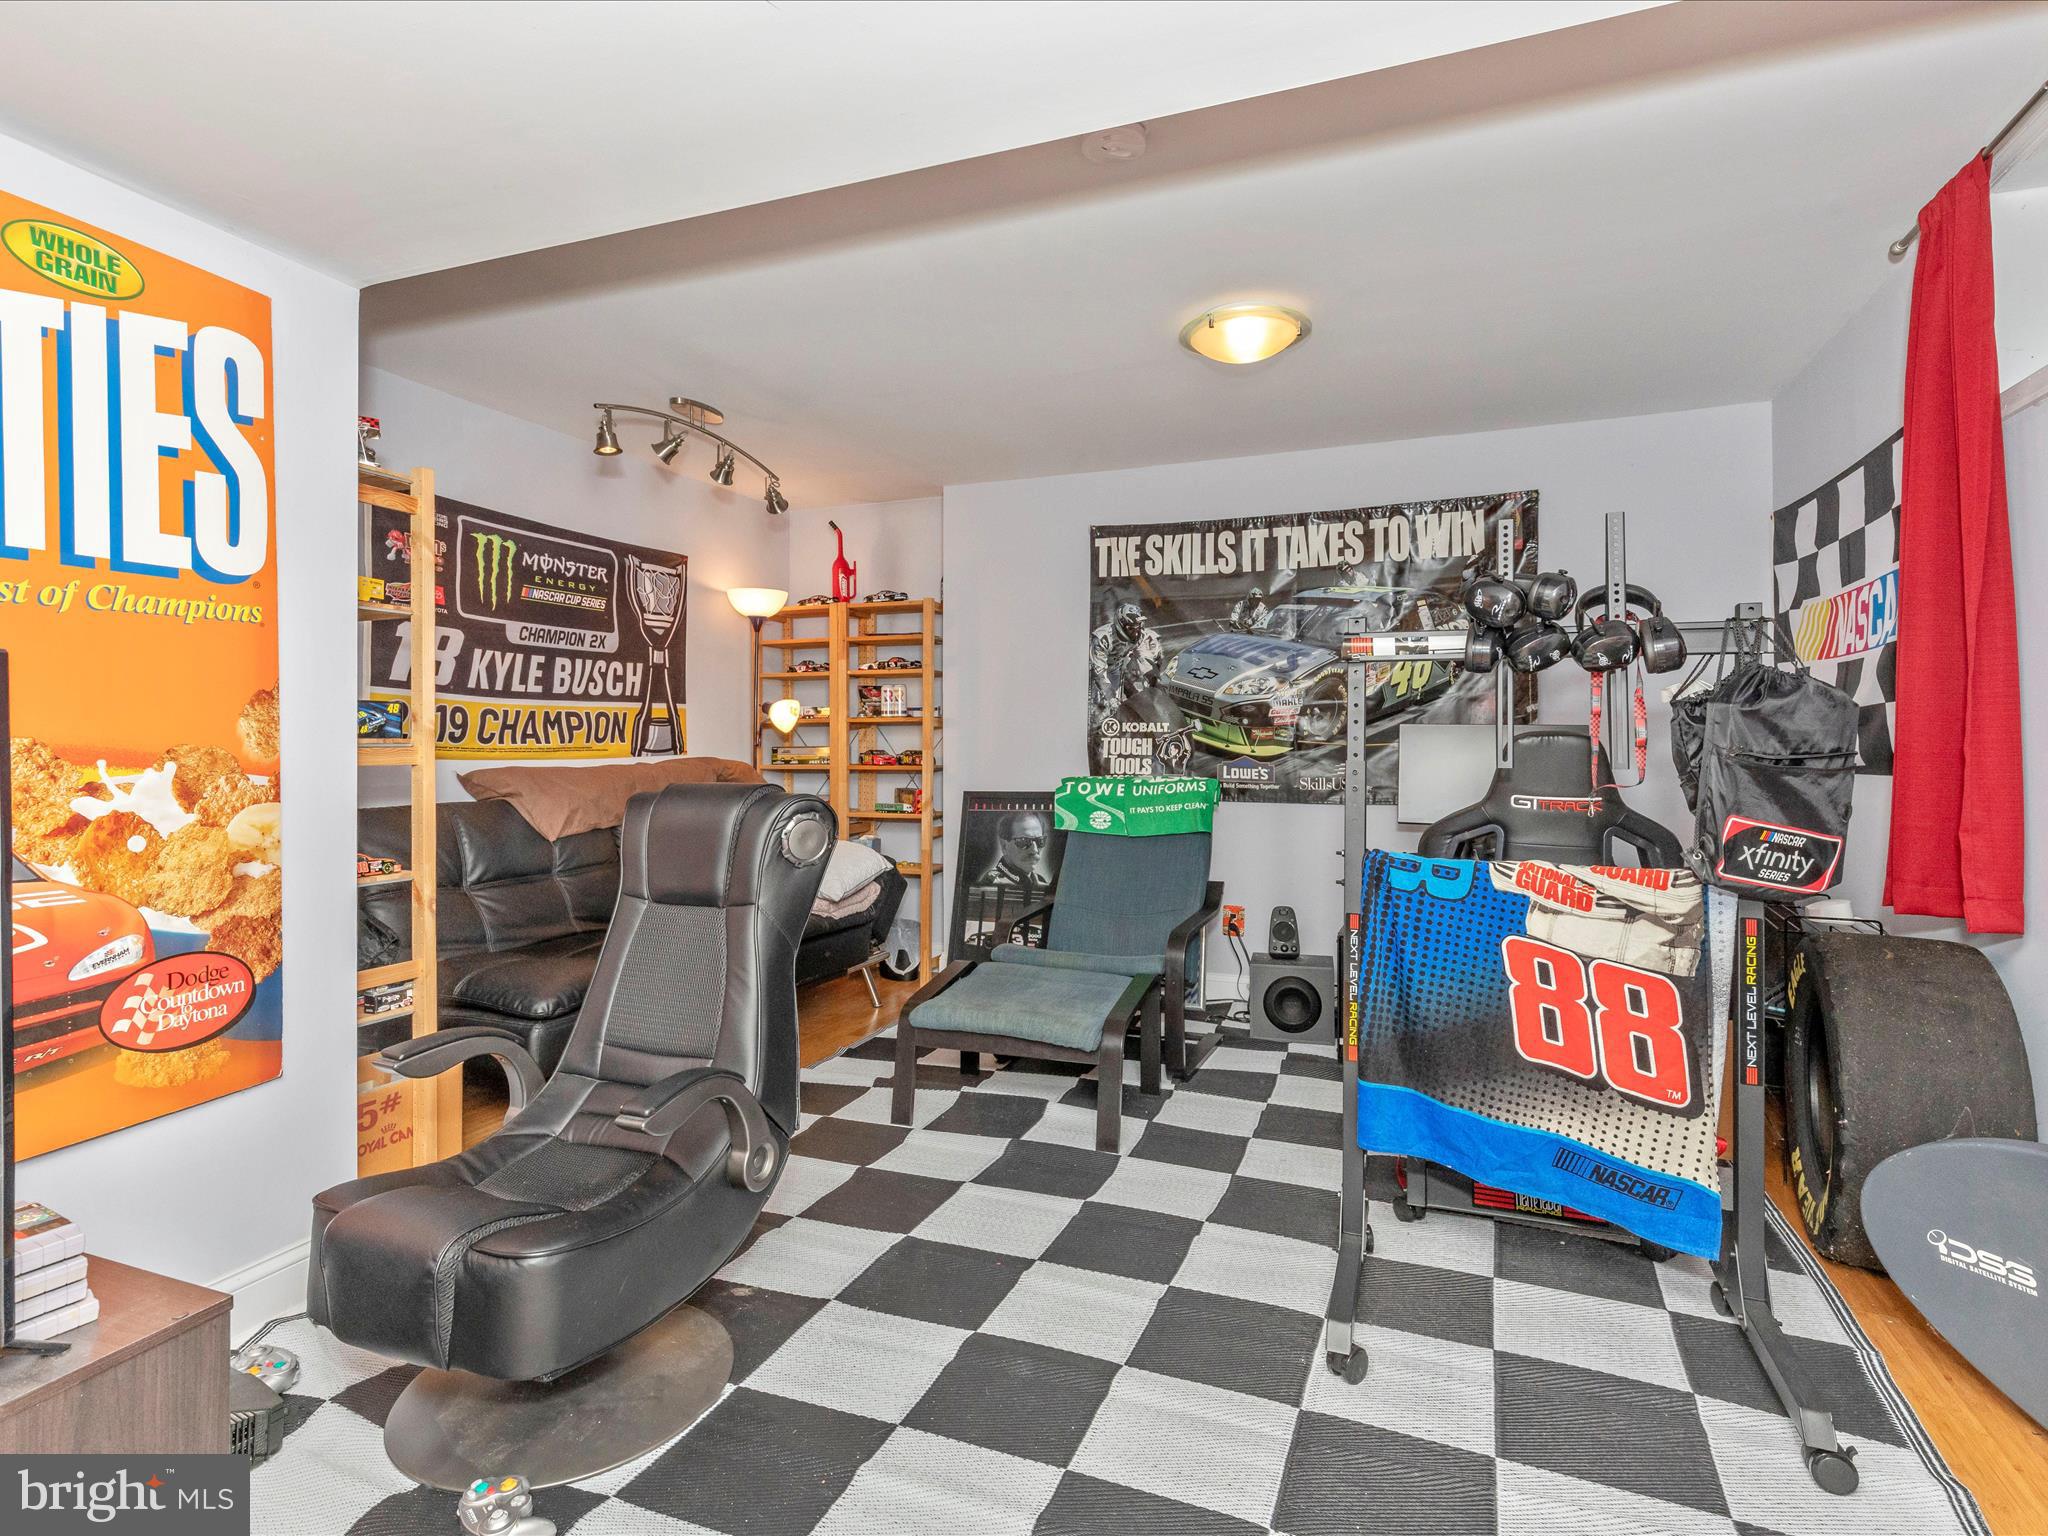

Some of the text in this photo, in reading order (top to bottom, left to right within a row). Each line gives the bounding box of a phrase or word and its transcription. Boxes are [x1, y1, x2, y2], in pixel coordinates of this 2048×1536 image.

[29, 225, 121, 276] WHOLE
[36, 250, 118, 294] GRAIN
[1095, 509, 1486, 577] THE SKILLS IT TAKES TO WIN
[522, 552, 608, 583] MONSTER
[532, 588, 606, 610] NASCAR CUP SERIES
[535, 575, 595, 592] ENERGY
[40, 579, 80, 613] of
[87, 583, 263, 624] Champions
[519, 626, 607, 649] CHAMPION 2X
[467, 648, 643, 696] KYLE BUSCH
[477, 708, 628, 745] CHAMPION
[1122, 722, 1170, 732] KOBALT
[1101, 737, 1153, 758] TOUGH
[1109, 754, 1152, 774] TOOLS
[1223, 765, 1269, 780] LOWE'S
[1132, 781, 1207, 796] UNIFORMS
[1137, 806, 1154, 814] PAYS
[1166, 804, 1183, 812] KEEP
[1184, 802, 1207, 810] CLEAN
[1771, 832, 1807, 847] NASCAR
[1738, 843, 1815, 879] xfinity
[1758, 868, 1792, 882] SERIES
[1515, 870, 1594, 913] GUARD
[168, 965, 230, 990] Dodge
[1349, 929, 1359, 1045] NEXT LEVEL RACING
[140, 979, 245, 1015] Countdown
[181, 1003, 193, 1015] to
[1747, 936, 1757, 1068] NEXT LEVEL RACING
[157, 1003, 228, 1032] Daytona
[1501, 935, 1691, 1108] 88
[1589, 1167, 1672, 1206] NASCAR
[1940, 1254, 2038, 1297] DIGITAL SATELLITE SYSTEM
